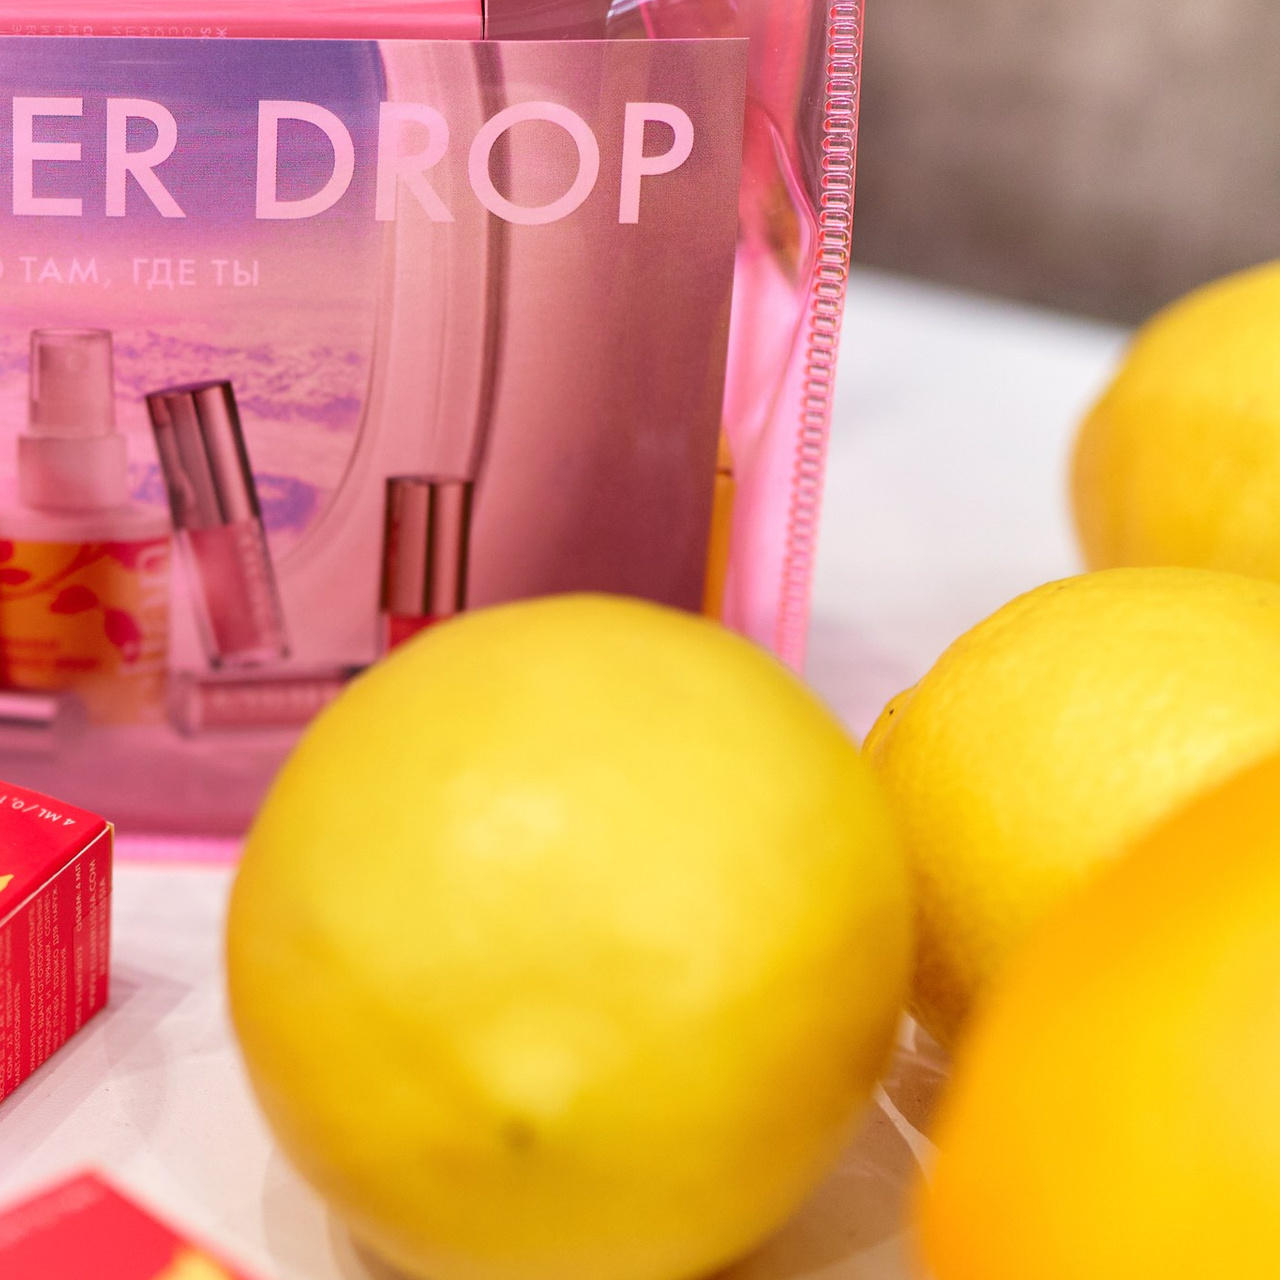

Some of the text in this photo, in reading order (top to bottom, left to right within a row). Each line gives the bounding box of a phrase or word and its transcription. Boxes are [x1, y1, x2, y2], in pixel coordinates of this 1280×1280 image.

[256, 99, 695, 225] DROP
[21, 256, 112, 288] ТАМ,
[131, 259, 196, 287] ГДЕ
[211, 260, 260, 286] ТЫ
[38, 808, 62, 822] ML
[62, 818, 76, 826] 4
